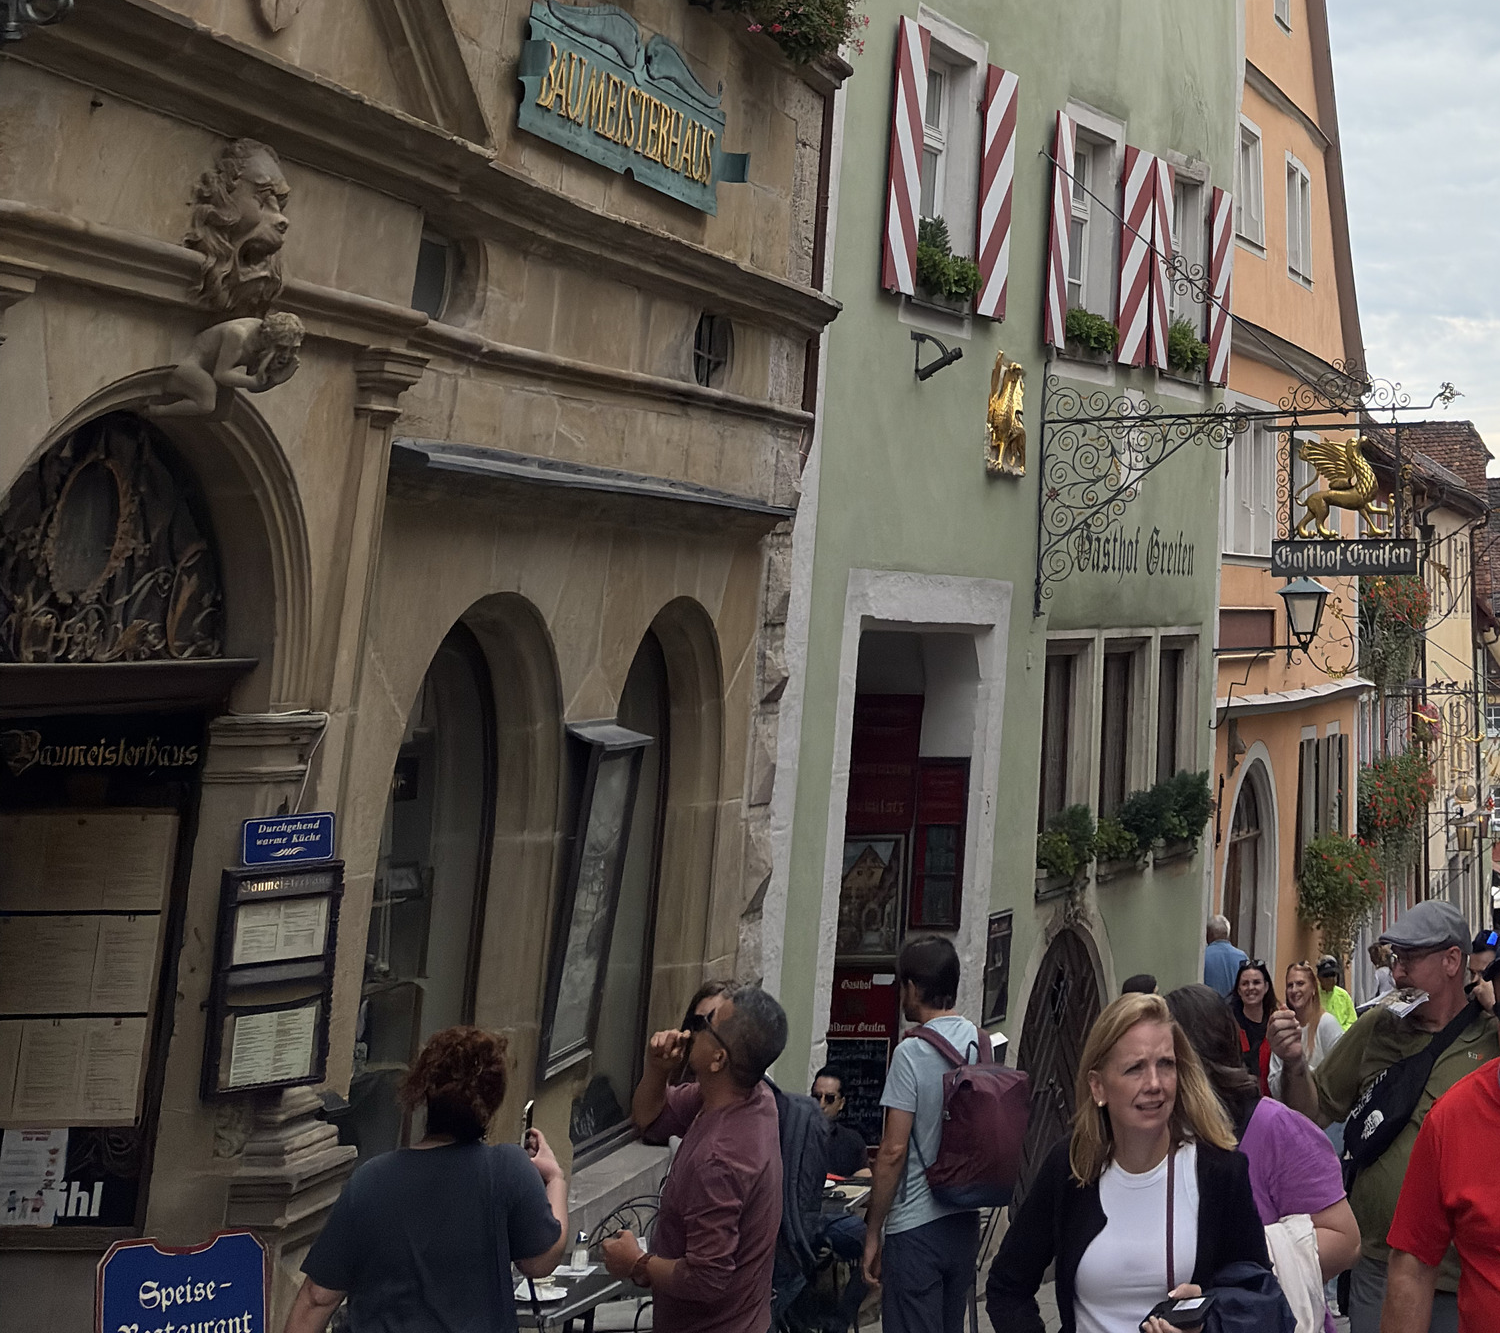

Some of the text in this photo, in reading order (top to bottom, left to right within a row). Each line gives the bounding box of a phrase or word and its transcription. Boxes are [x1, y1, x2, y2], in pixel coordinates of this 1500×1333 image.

[535, 41, 716, 186] BAUMEISTERHAUS
[1075, 522, 1195, 584] Gasthof Greifen
[1346, 542, 1412, 568] Greifen
[4, 729, 199, 777] Baumeisterhaus
[255, 832, 322, 846] warme Küche
[257, 819, 321, 834] Durchgehend
[138, 1276, 233, 1313] Speise-
